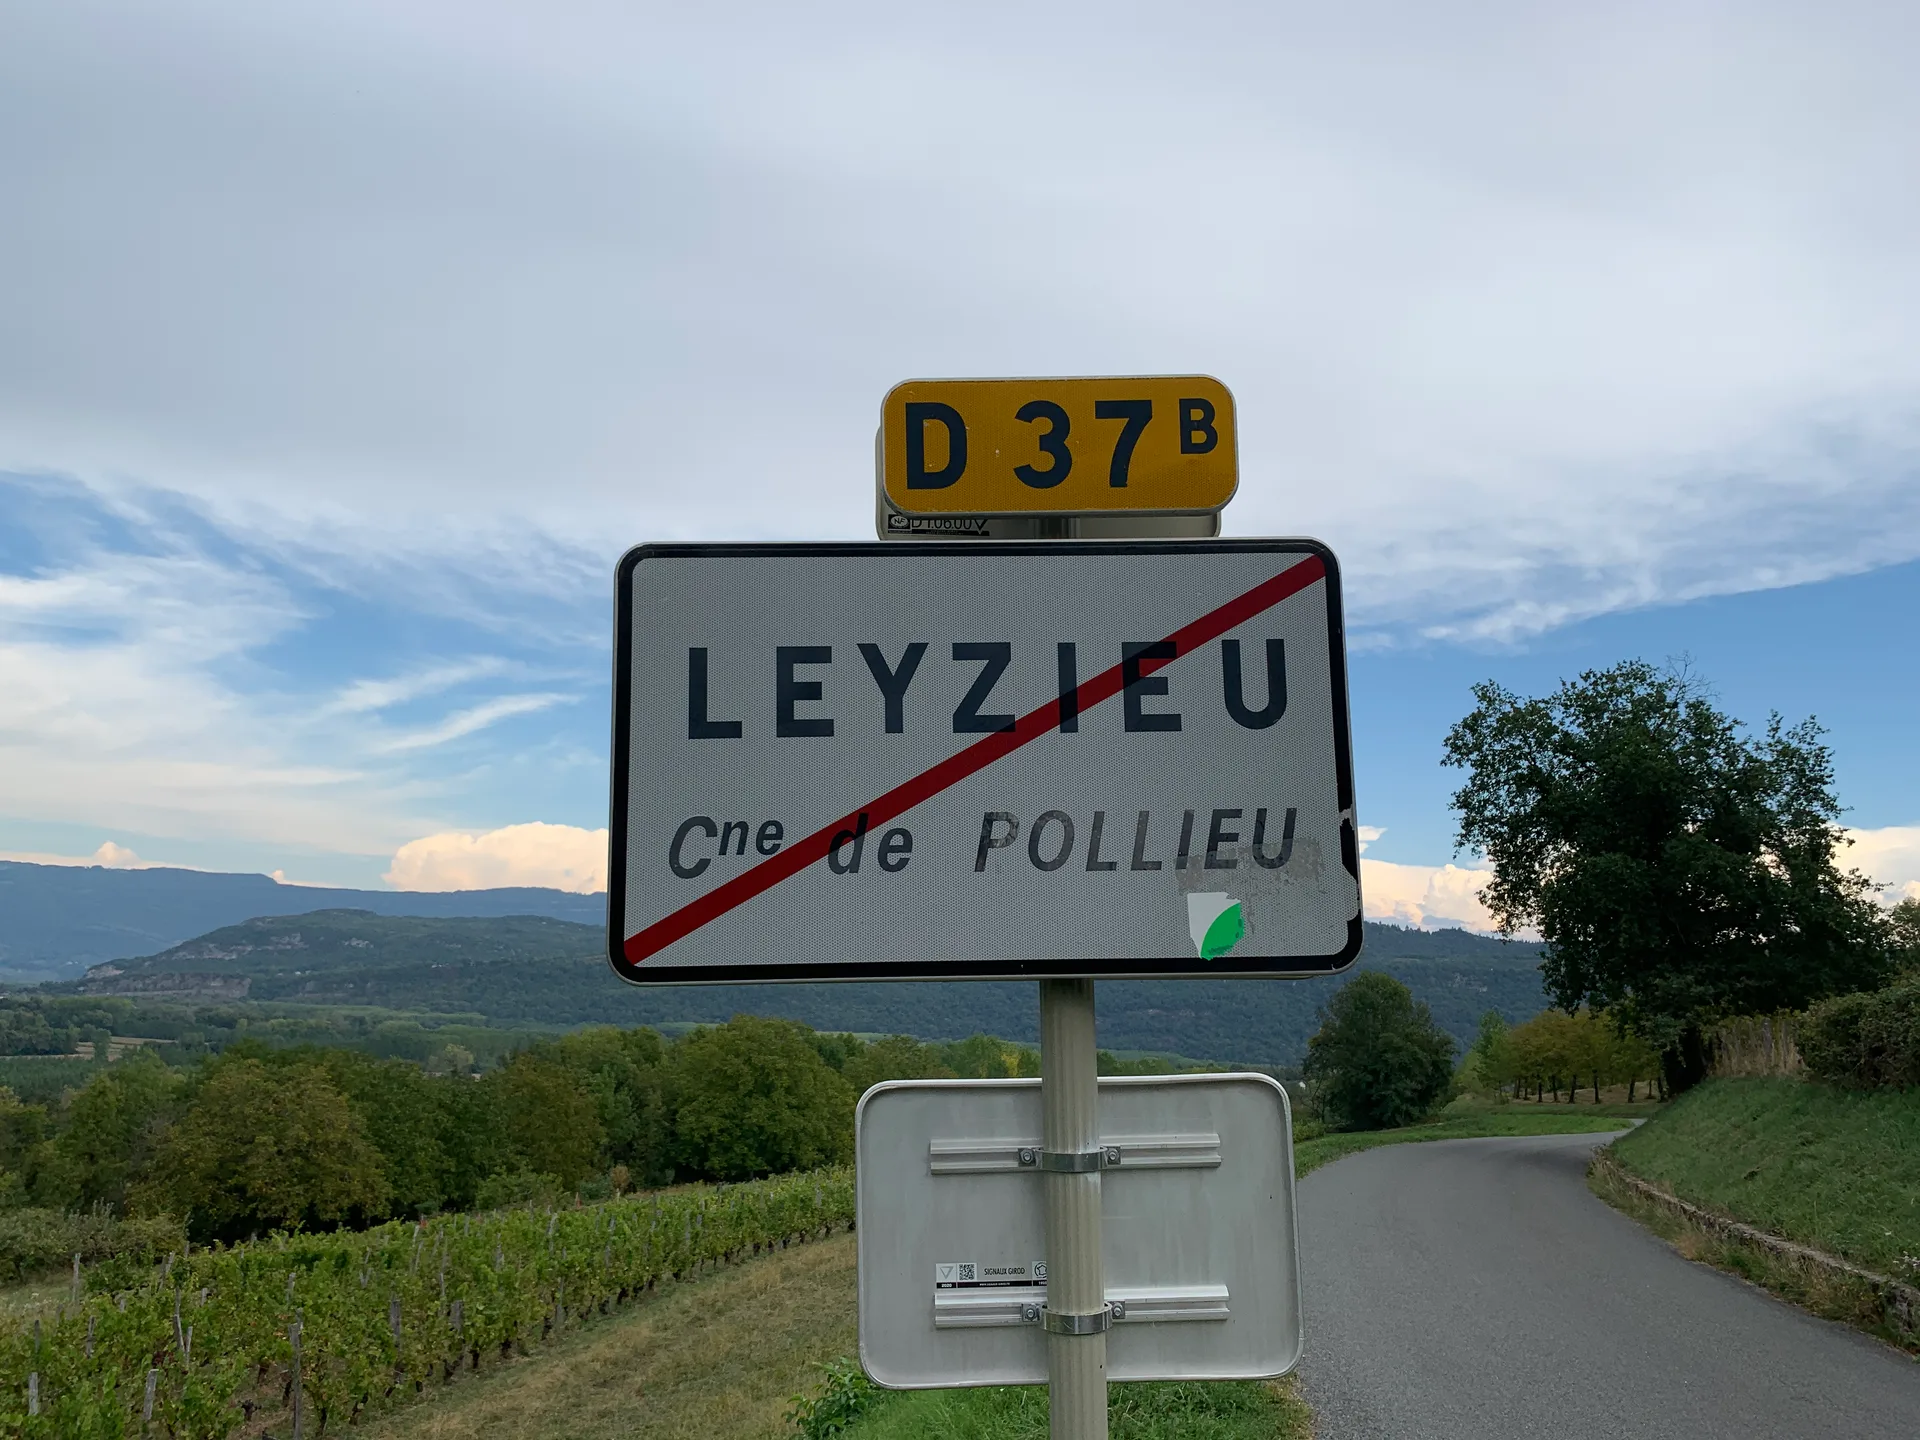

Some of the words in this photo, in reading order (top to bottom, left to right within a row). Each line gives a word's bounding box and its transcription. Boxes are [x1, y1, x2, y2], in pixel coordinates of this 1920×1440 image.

[905, 402, 967, 490] D
[688, 639, 1290, 740] LEYZIEU
[668, 815, 784, 879] Cne
[828, 812, 914, 875] de
[971, 808, 1297, 872] POLLIEU
[984, 1267, 1007, 1276] SIGNAUX
[1008, 1267, 1025, 1275] GIROD
